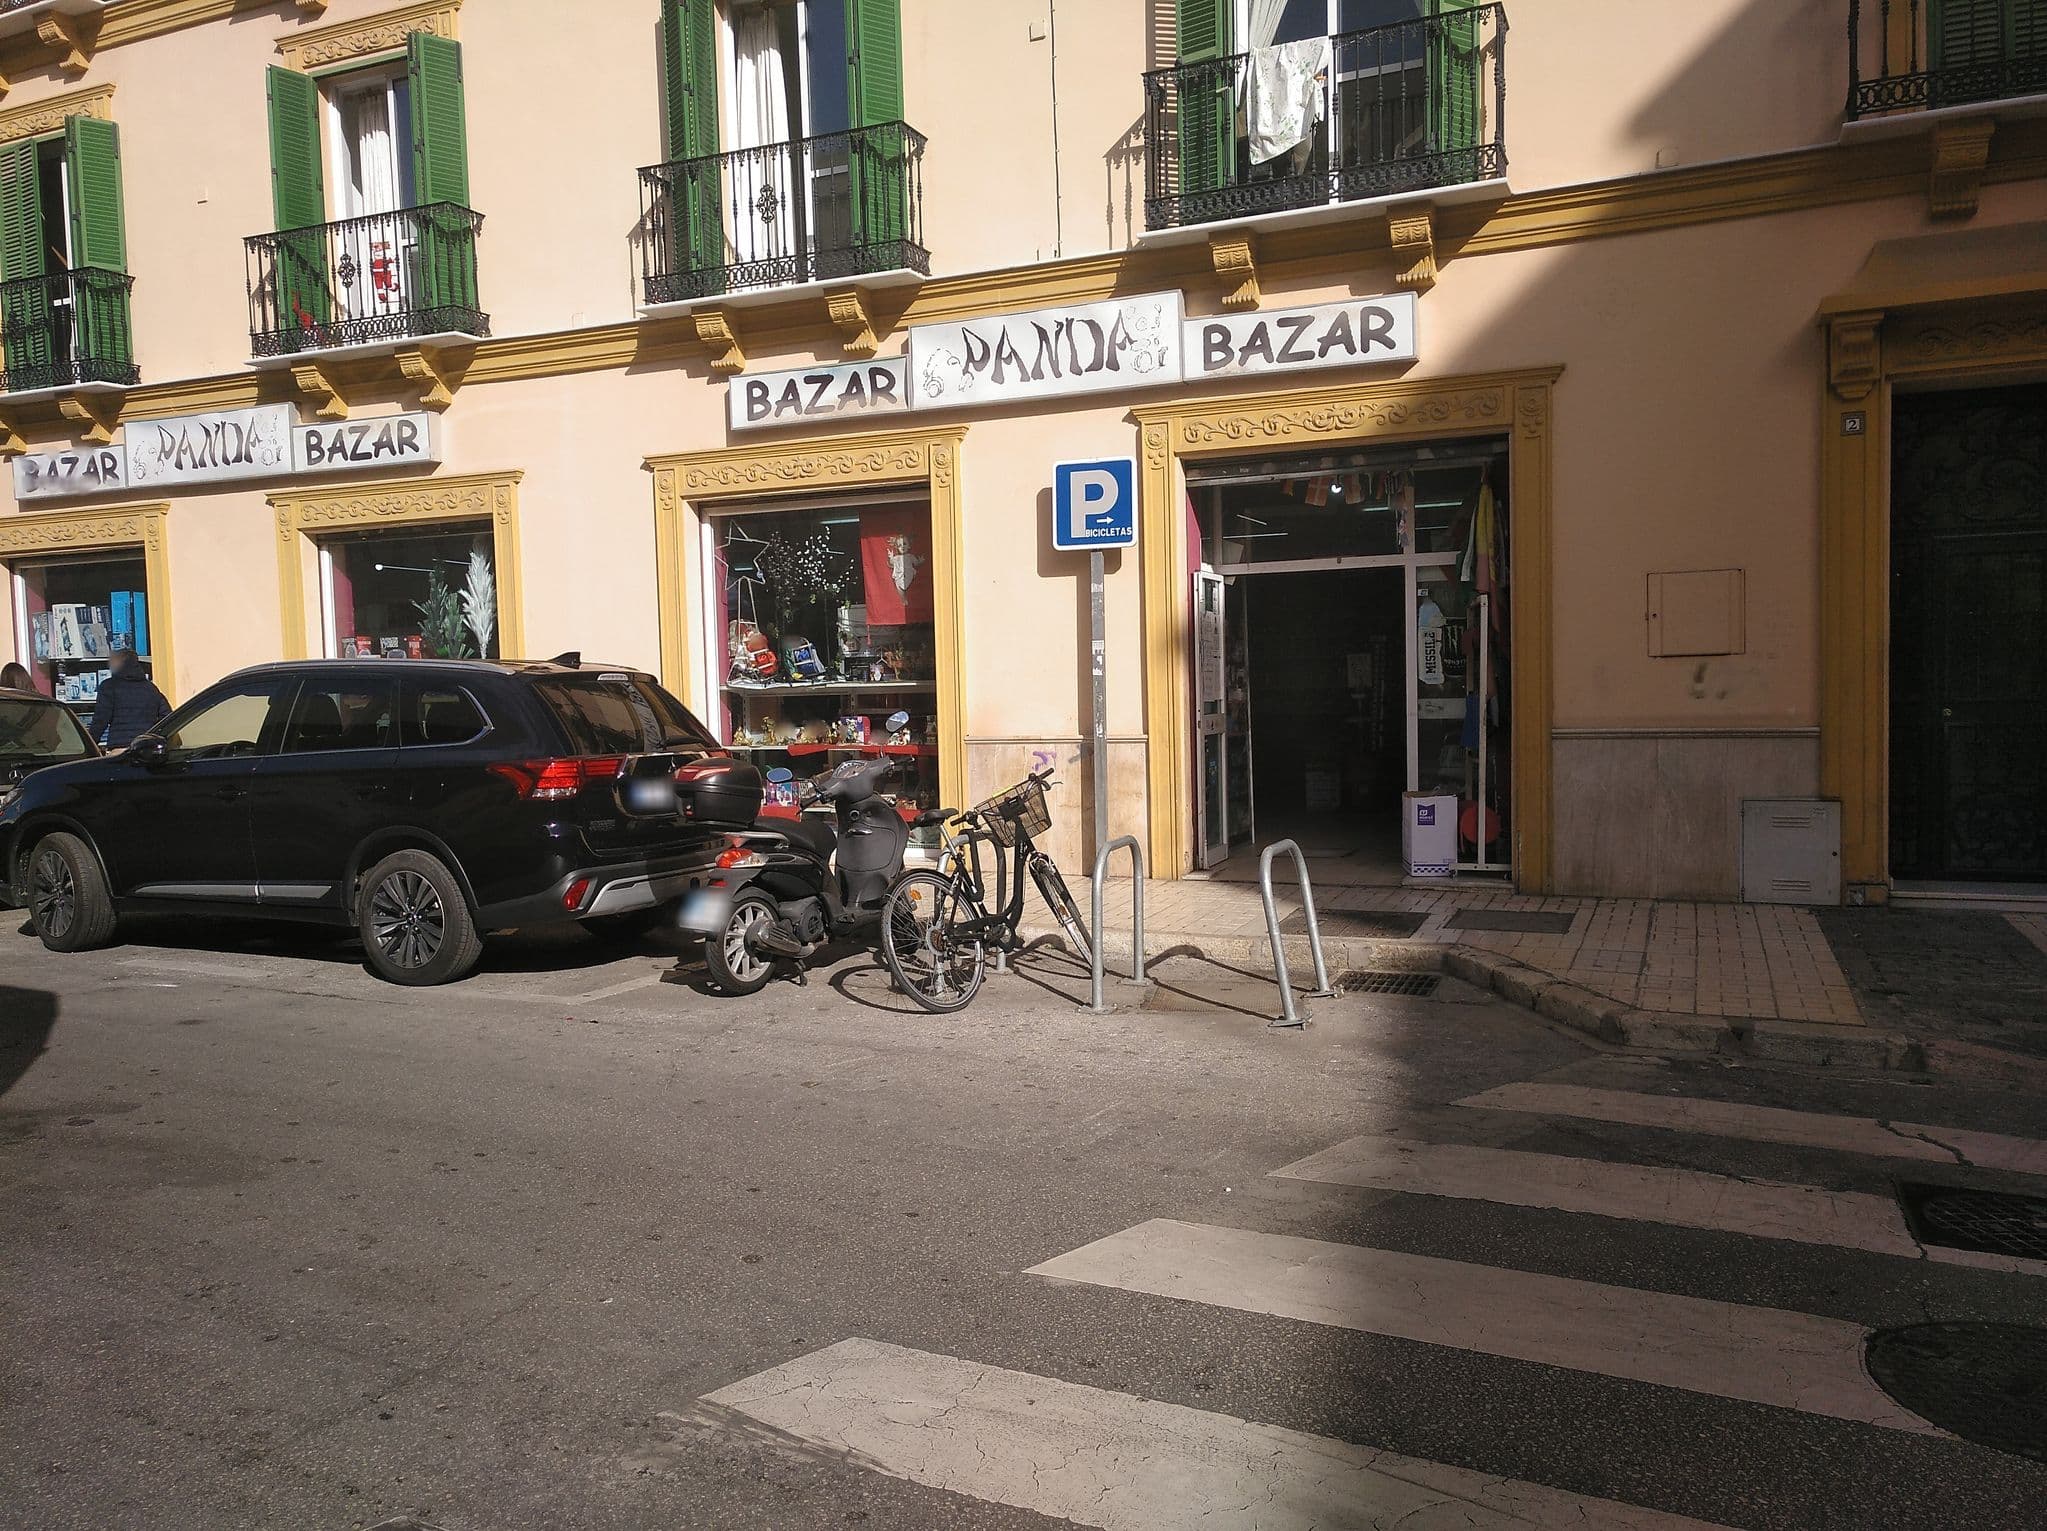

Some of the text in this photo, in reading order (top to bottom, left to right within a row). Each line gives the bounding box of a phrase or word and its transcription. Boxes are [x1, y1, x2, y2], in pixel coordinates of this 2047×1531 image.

[746, 306, 1397, 421] BAZAR PANDA BAZAR
[157, 416, 263, 470] PANDA
[305, 419, 420, 466] BAZAR
[1848, 419, 1858, 430] 2
[1070, 469, 1119, 538] P
[1085, 527, 1132, 538] BICICLETAS
[1424, 631, 1436, 674] MISSILE
